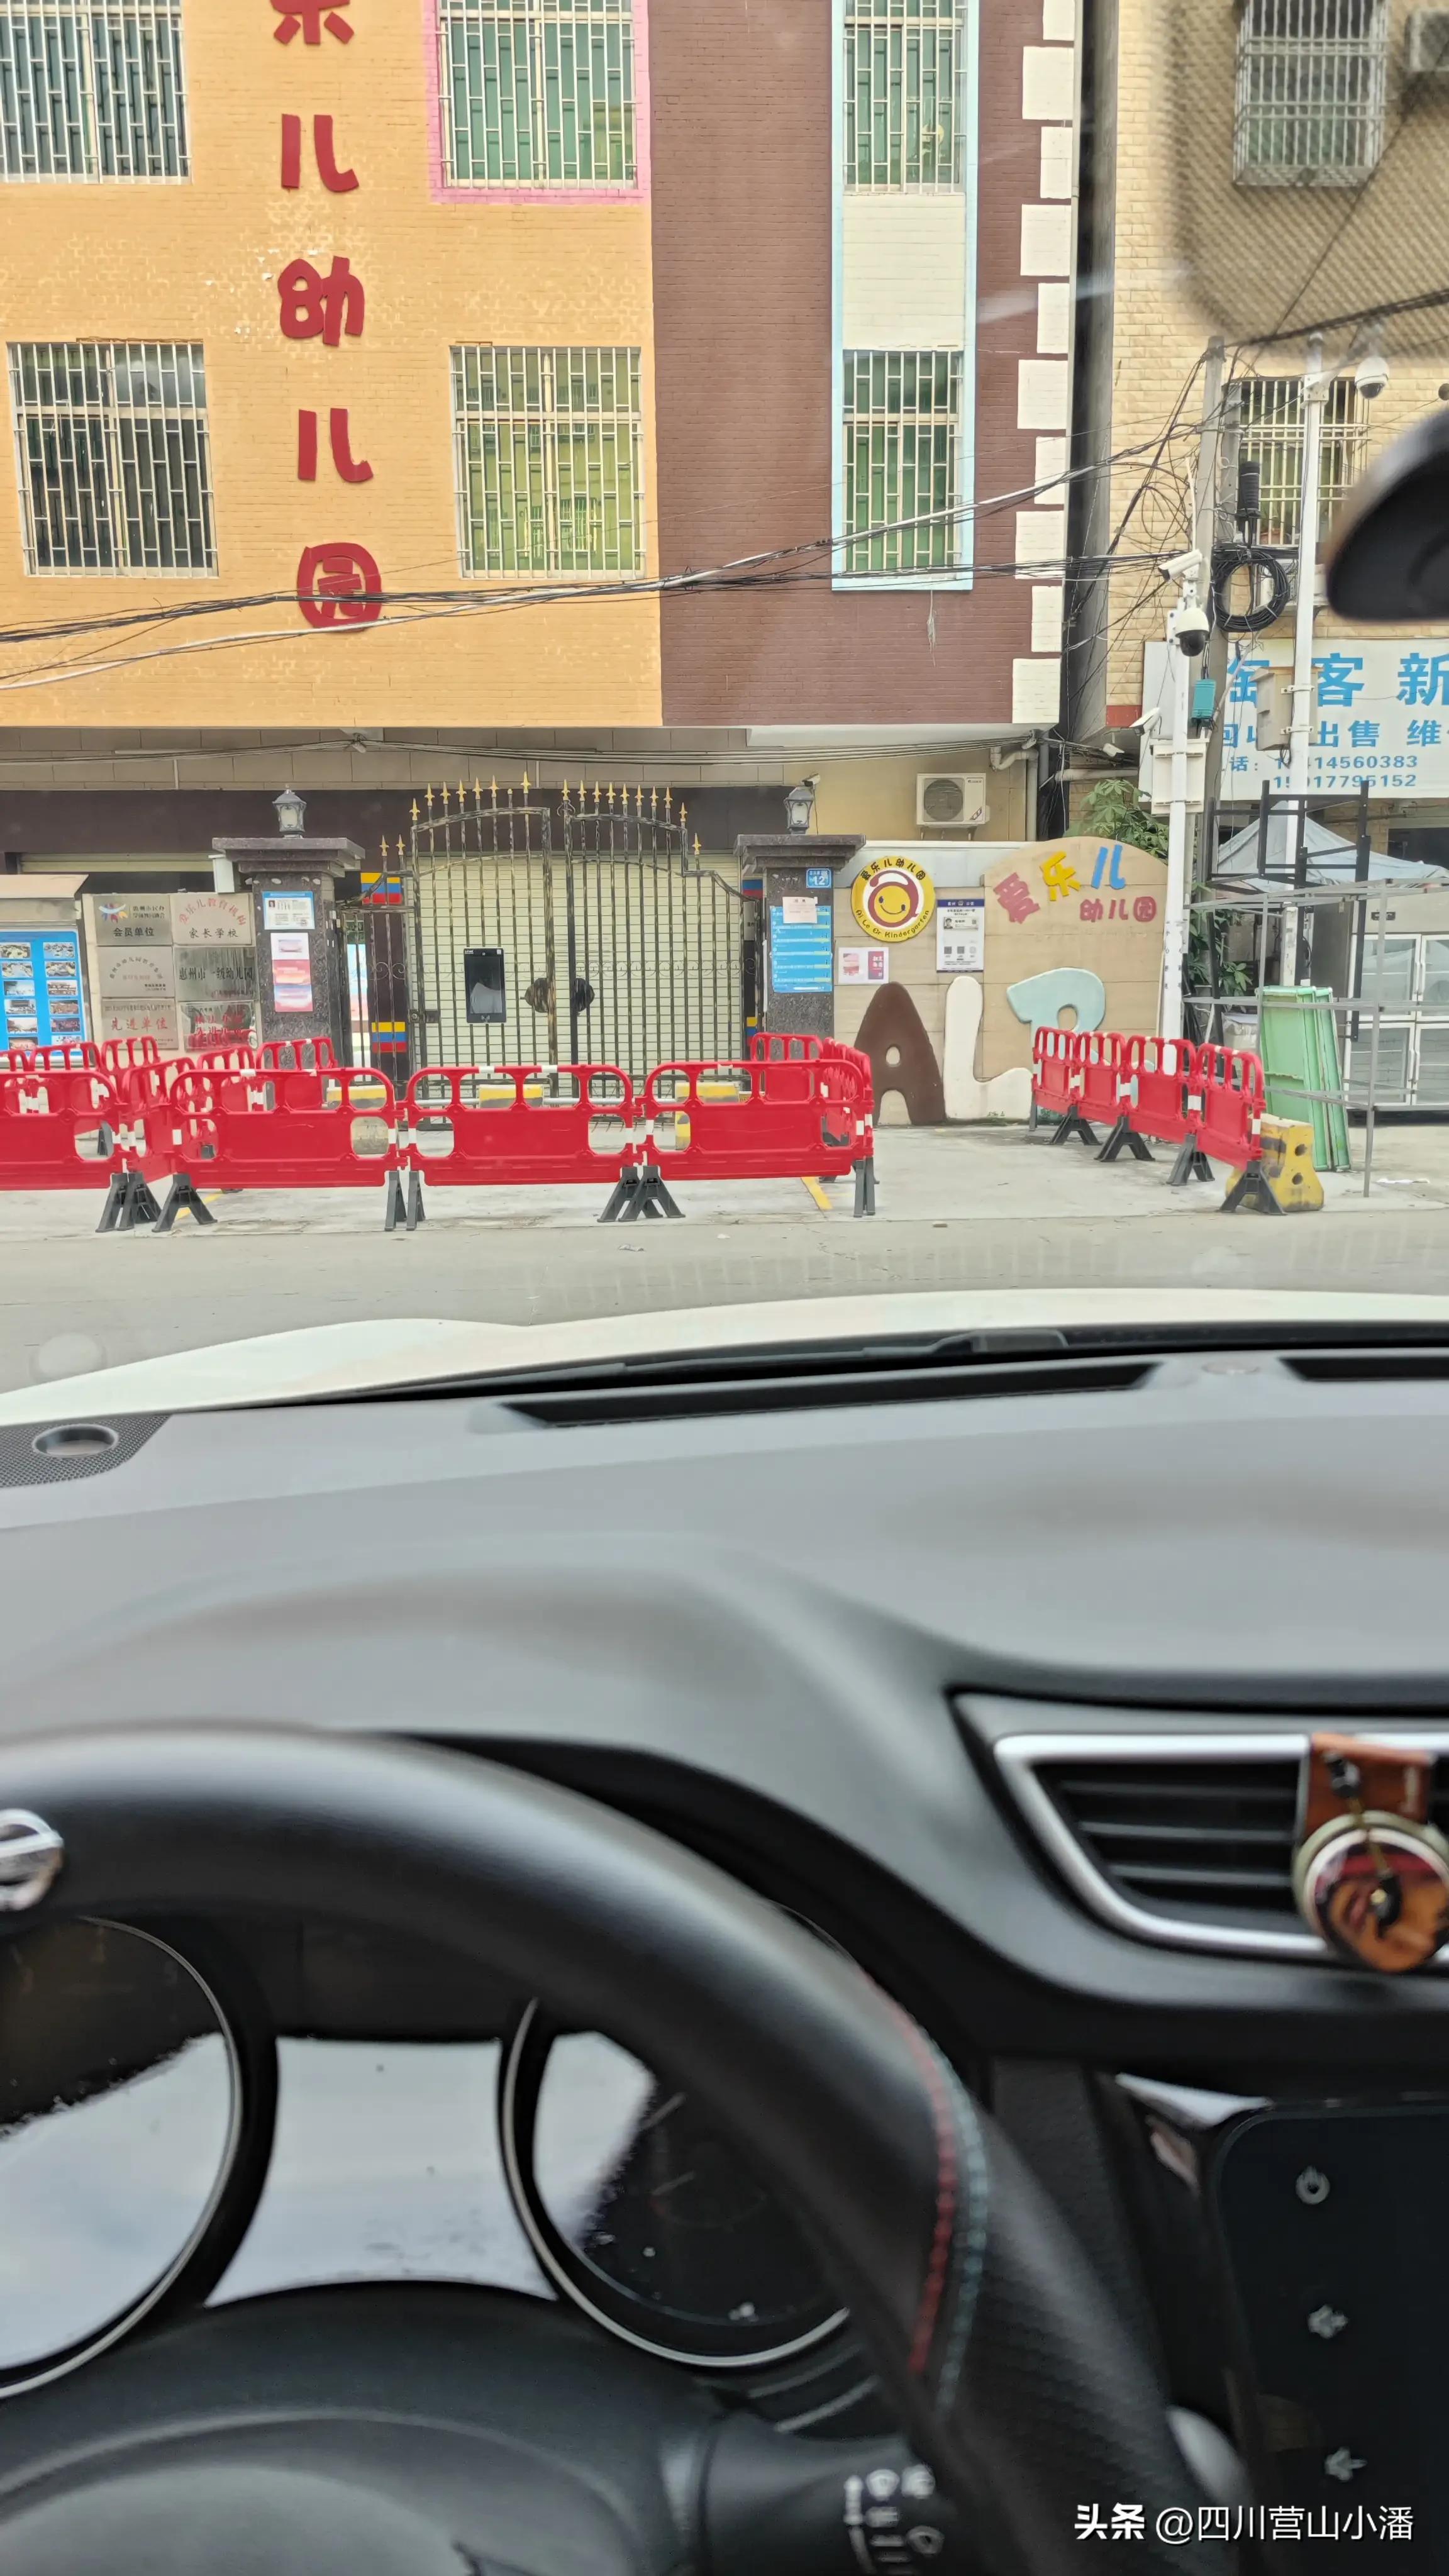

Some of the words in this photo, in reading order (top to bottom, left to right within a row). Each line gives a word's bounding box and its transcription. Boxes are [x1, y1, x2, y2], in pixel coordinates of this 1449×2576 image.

[1308, 719, 1380, 748] 出售
[1274, 754, 1418, 769] 114560383
[1273, 774, 1417, 789] 117795152
[860, 858, 926, 882] 爱乐儿幼儿园
[993, 844, 1126, 924] 爱乐儿
[1079, 896, 1157, 923] 幼儿园
[113, 927, 155, 938] 会员单位
[189, 928, 239, 938] 家长学校
[884, 909, 930, 939] Kindergarten
[111, 1016, 169, 1032] 先进单位
